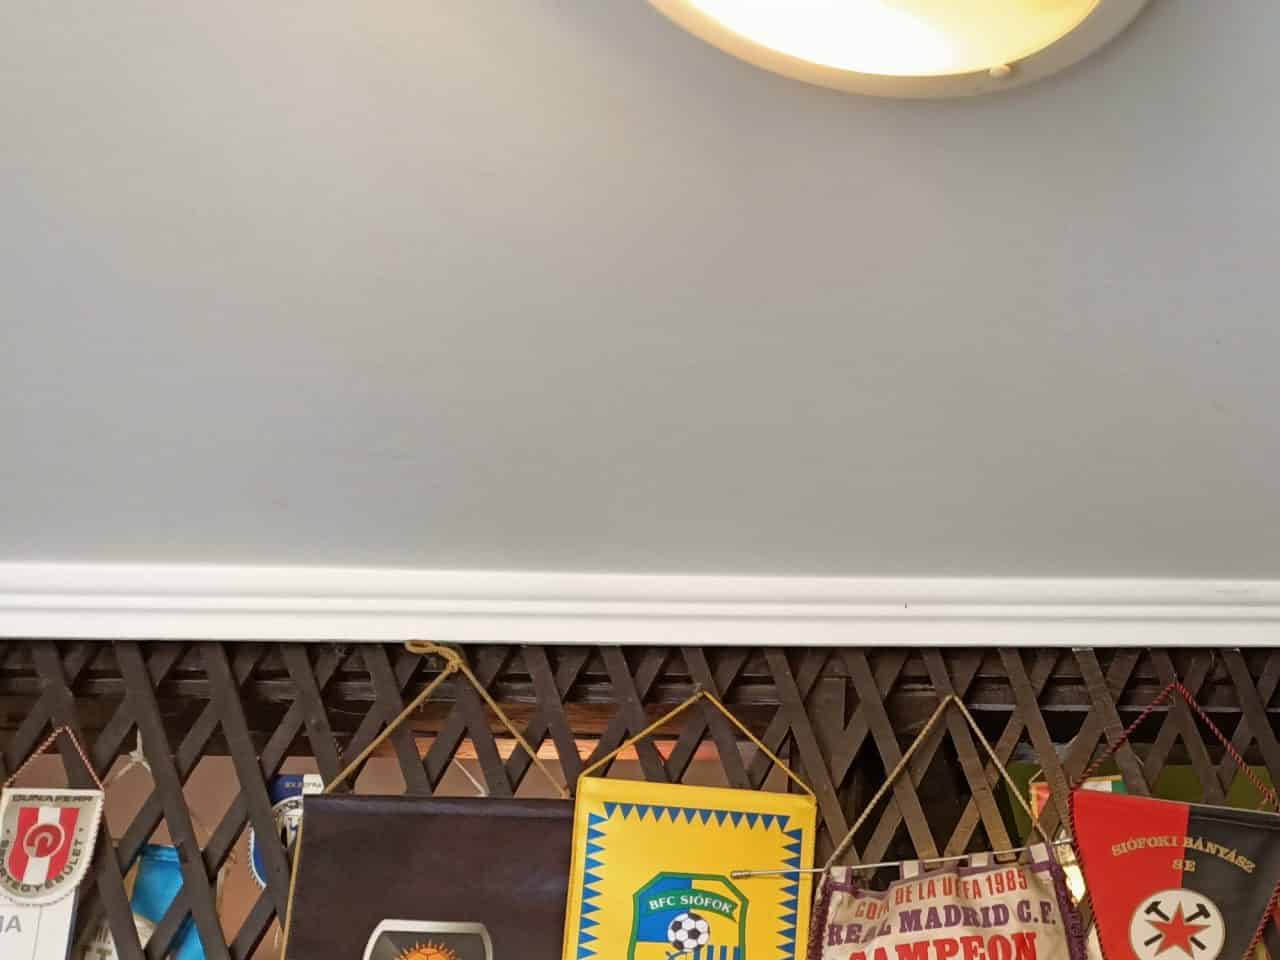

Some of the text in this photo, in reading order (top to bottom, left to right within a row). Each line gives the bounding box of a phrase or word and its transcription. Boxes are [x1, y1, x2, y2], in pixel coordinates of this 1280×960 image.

[1111, 834, 1256, 873] SIÓFOKI BÁNYÁSZ
[1172, 859, 1196, 872] SE
[917, 876, 938, 900] LA
[984, 867, 1029, 896] 1985
[648, 893, 734, 914] BFC SIÓFOK
[898, 903, 1010, 935] MADRID
